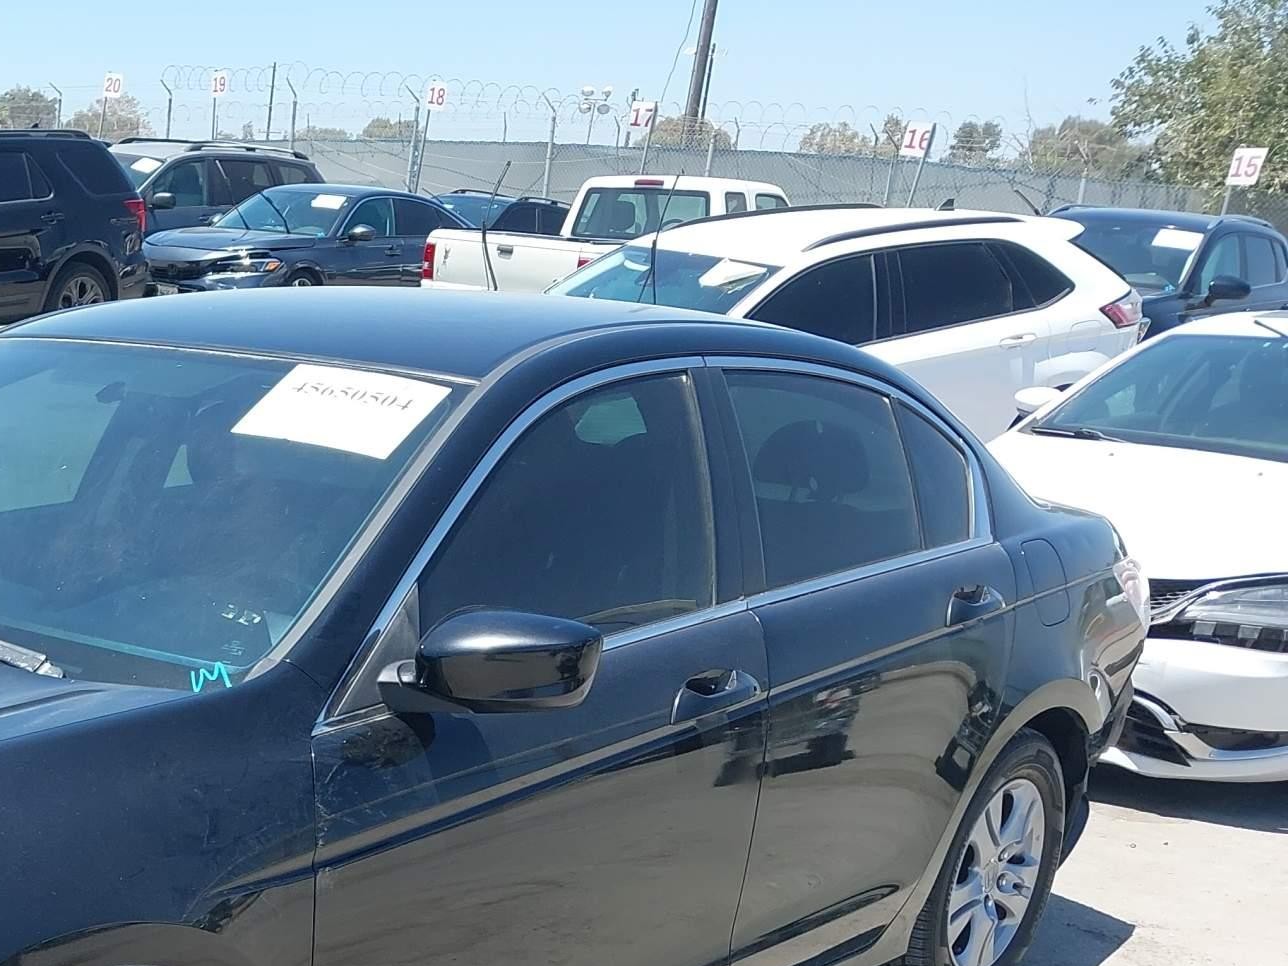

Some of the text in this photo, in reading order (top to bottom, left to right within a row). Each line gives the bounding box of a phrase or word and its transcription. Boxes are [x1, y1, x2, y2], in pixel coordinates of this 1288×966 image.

[104, 77, 121, 94] 20
[212, 76, 226, 93] 19
[427, 87, 446, 106] 18
[629, 107, 654, 128] 17
[903, 128, 931, 151] 16
[1230, 155, 1262, 178] 15
